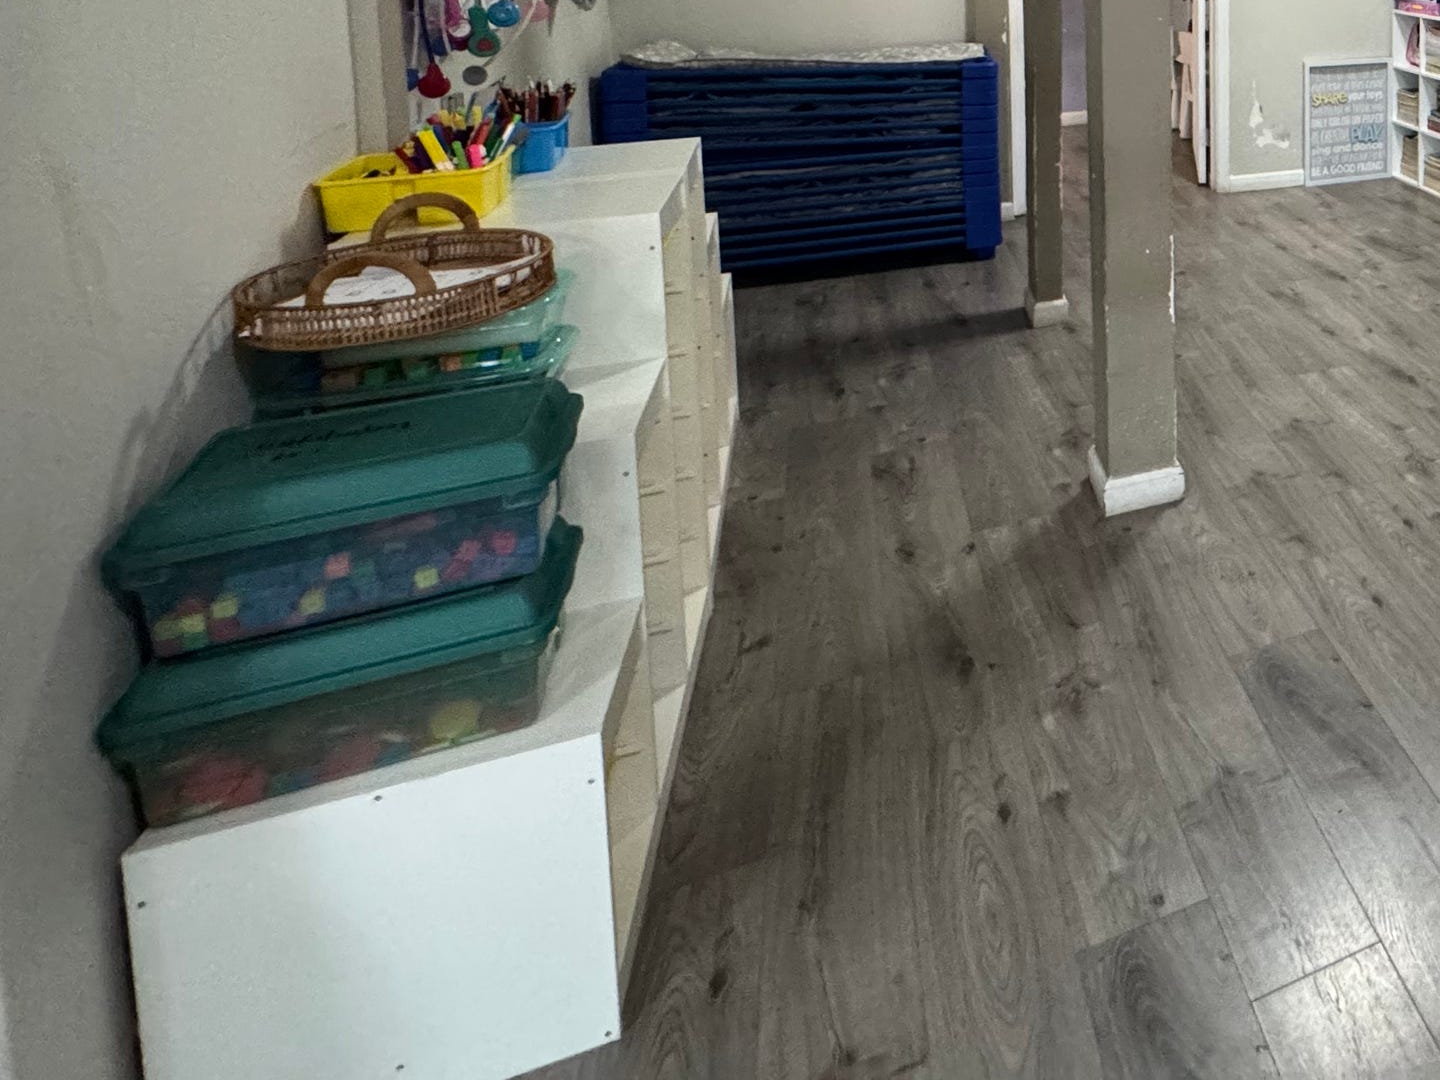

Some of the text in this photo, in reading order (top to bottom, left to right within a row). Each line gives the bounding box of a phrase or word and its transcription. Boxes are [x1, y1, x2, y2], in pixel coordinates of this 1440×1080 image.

[1351, 123, 1385, 142] PLAY
[1332, 144, 1351, 154] and
[1352, 142, 1384, 151] dance
[1311, 166, 1321, 177] BE
[1330, 163, 1356, 174] GOOD
[1357, 161, 1384, 172] FRIEND
